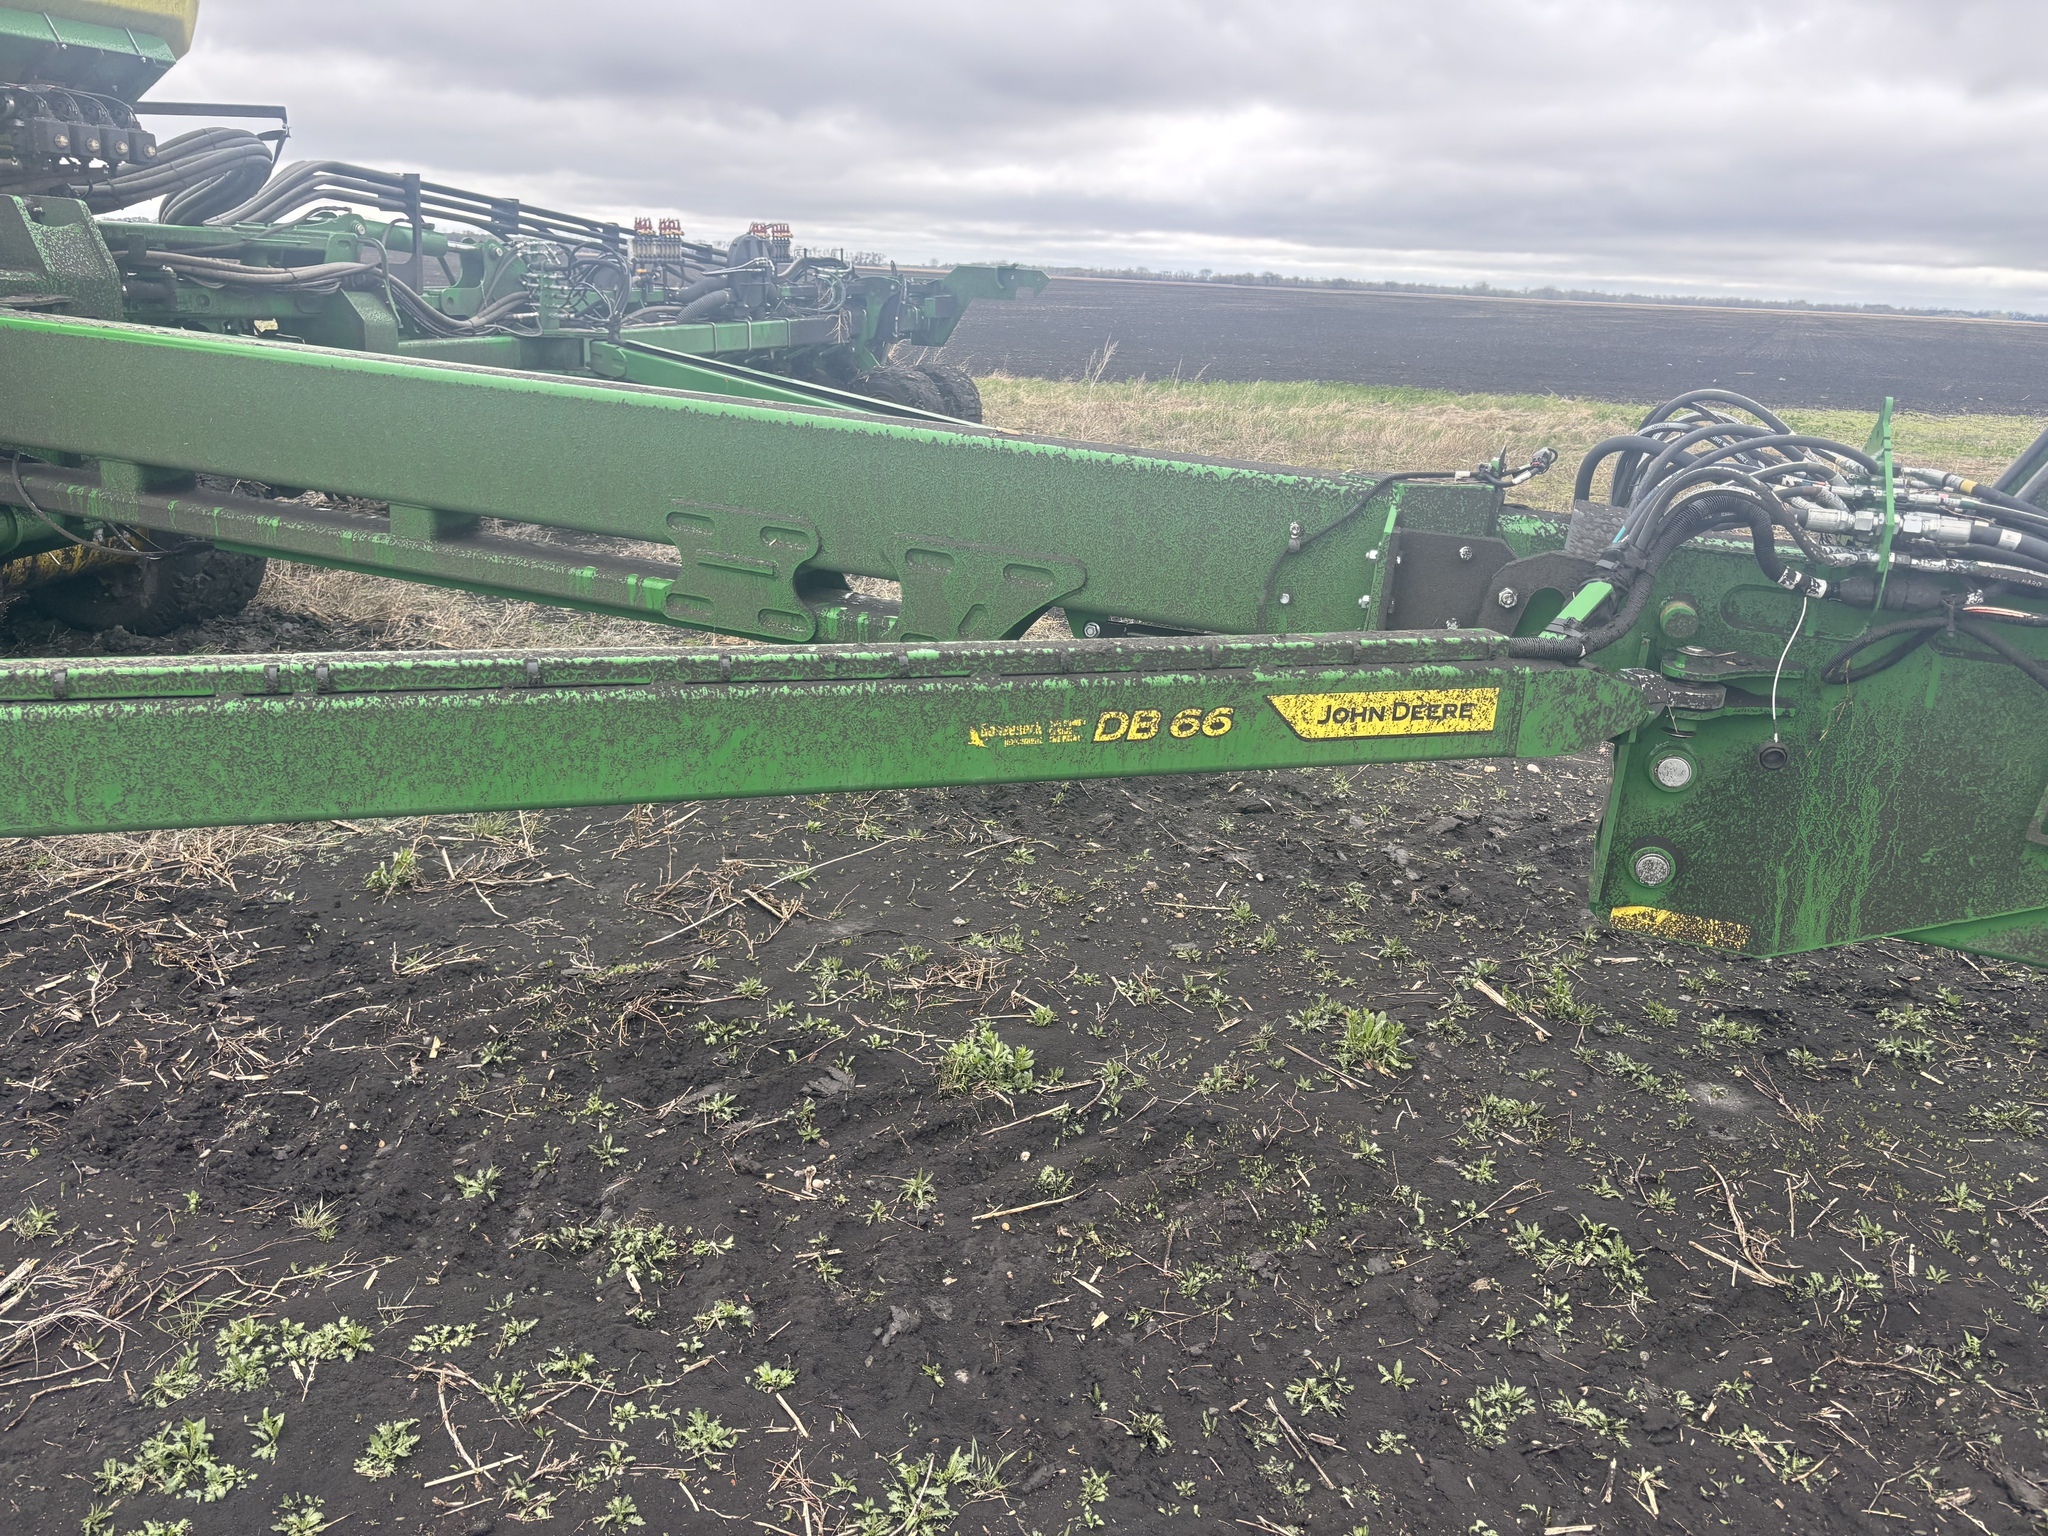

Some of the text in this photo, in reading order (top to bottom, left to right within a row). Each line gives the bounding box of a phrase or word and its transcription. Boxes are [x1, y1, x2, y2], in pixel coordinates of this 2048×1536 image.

[1093, 710, 1163, 742] DB
[1169, 706, 1235, 739] 66
[1317, 701, 1475, 724] JOHN DEERE
